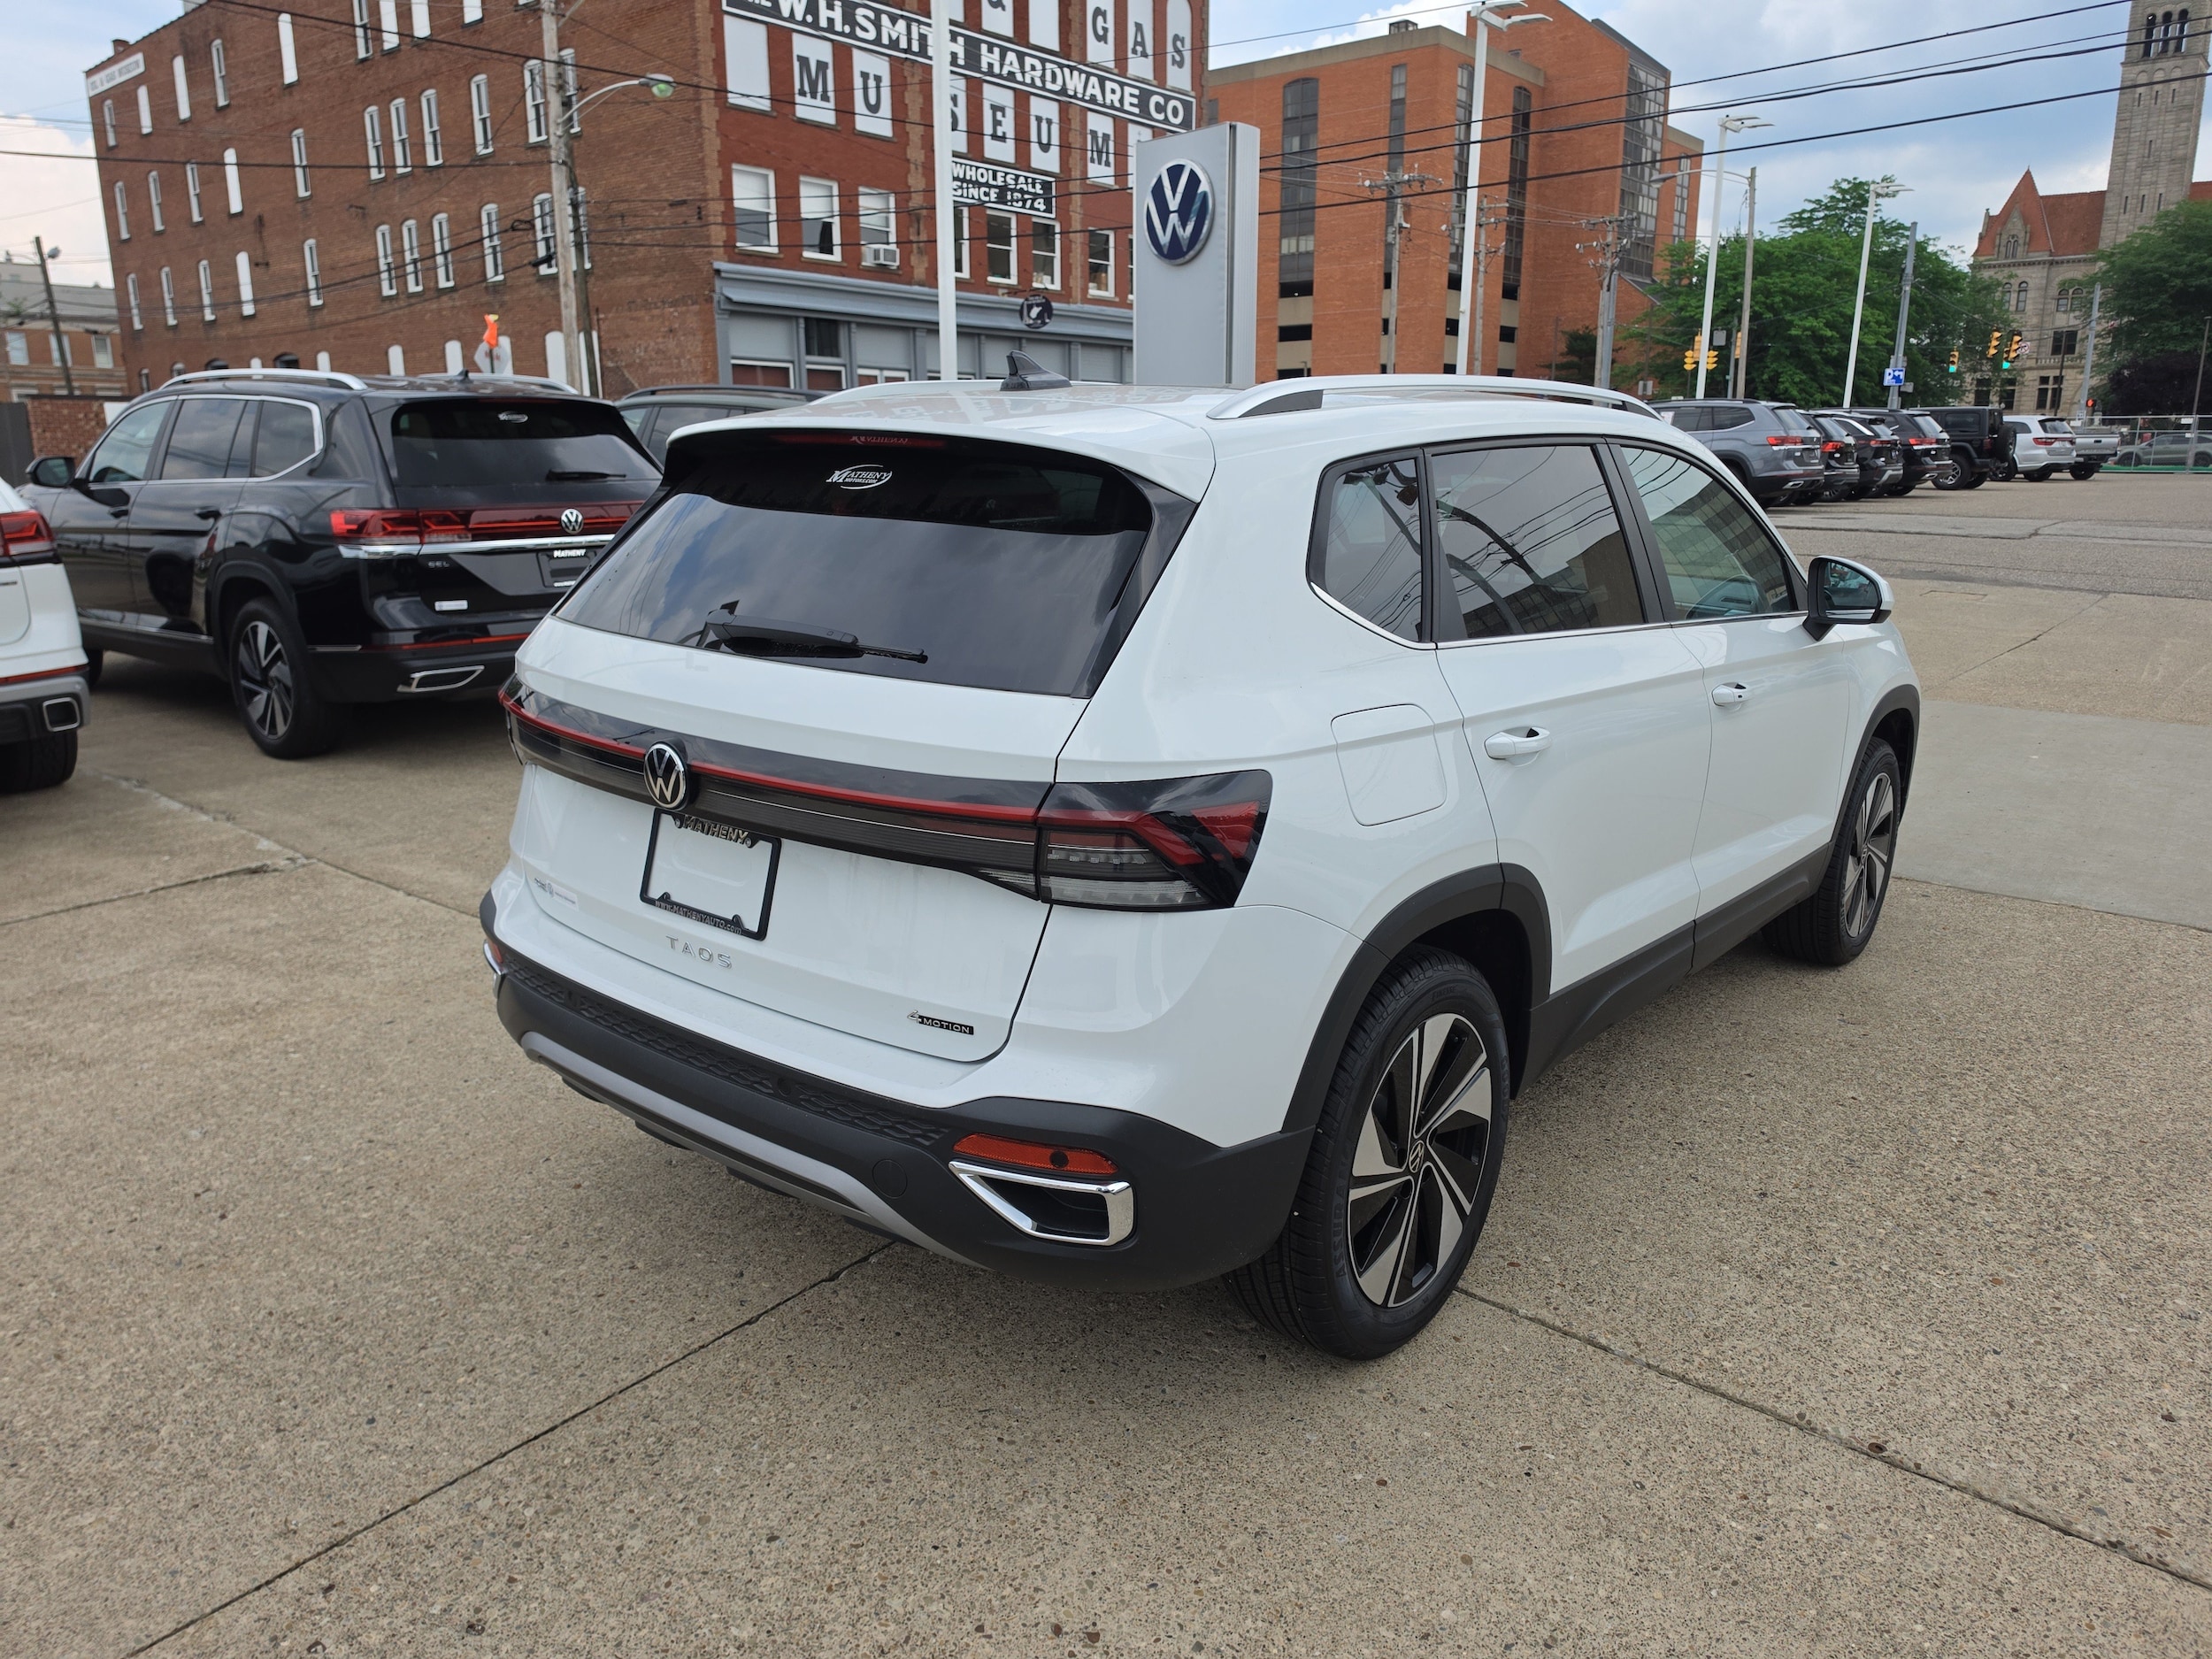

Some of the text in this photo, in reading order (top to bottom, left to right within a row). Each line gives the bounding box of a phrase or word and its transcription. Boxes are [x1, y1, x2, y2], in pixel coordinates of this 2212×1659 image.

[1092, 6, 1187, 69] GAS
[980, 43, 1141, 114] HARDWARE
[1148, 95, 1185, 126] CO
[951, 165, 1044, 195] WHOLESALE
[952, 180, 1047, 211] SINCE 1874
[826, 470, 888, 483] MATHENY
[554, 549, 586, 558] MATHENY
[683, 815, 749, 845] MATHENY
[665, 935, 733, 969] TAOS
[907, 1010, 971, 1034] 4MOTION
